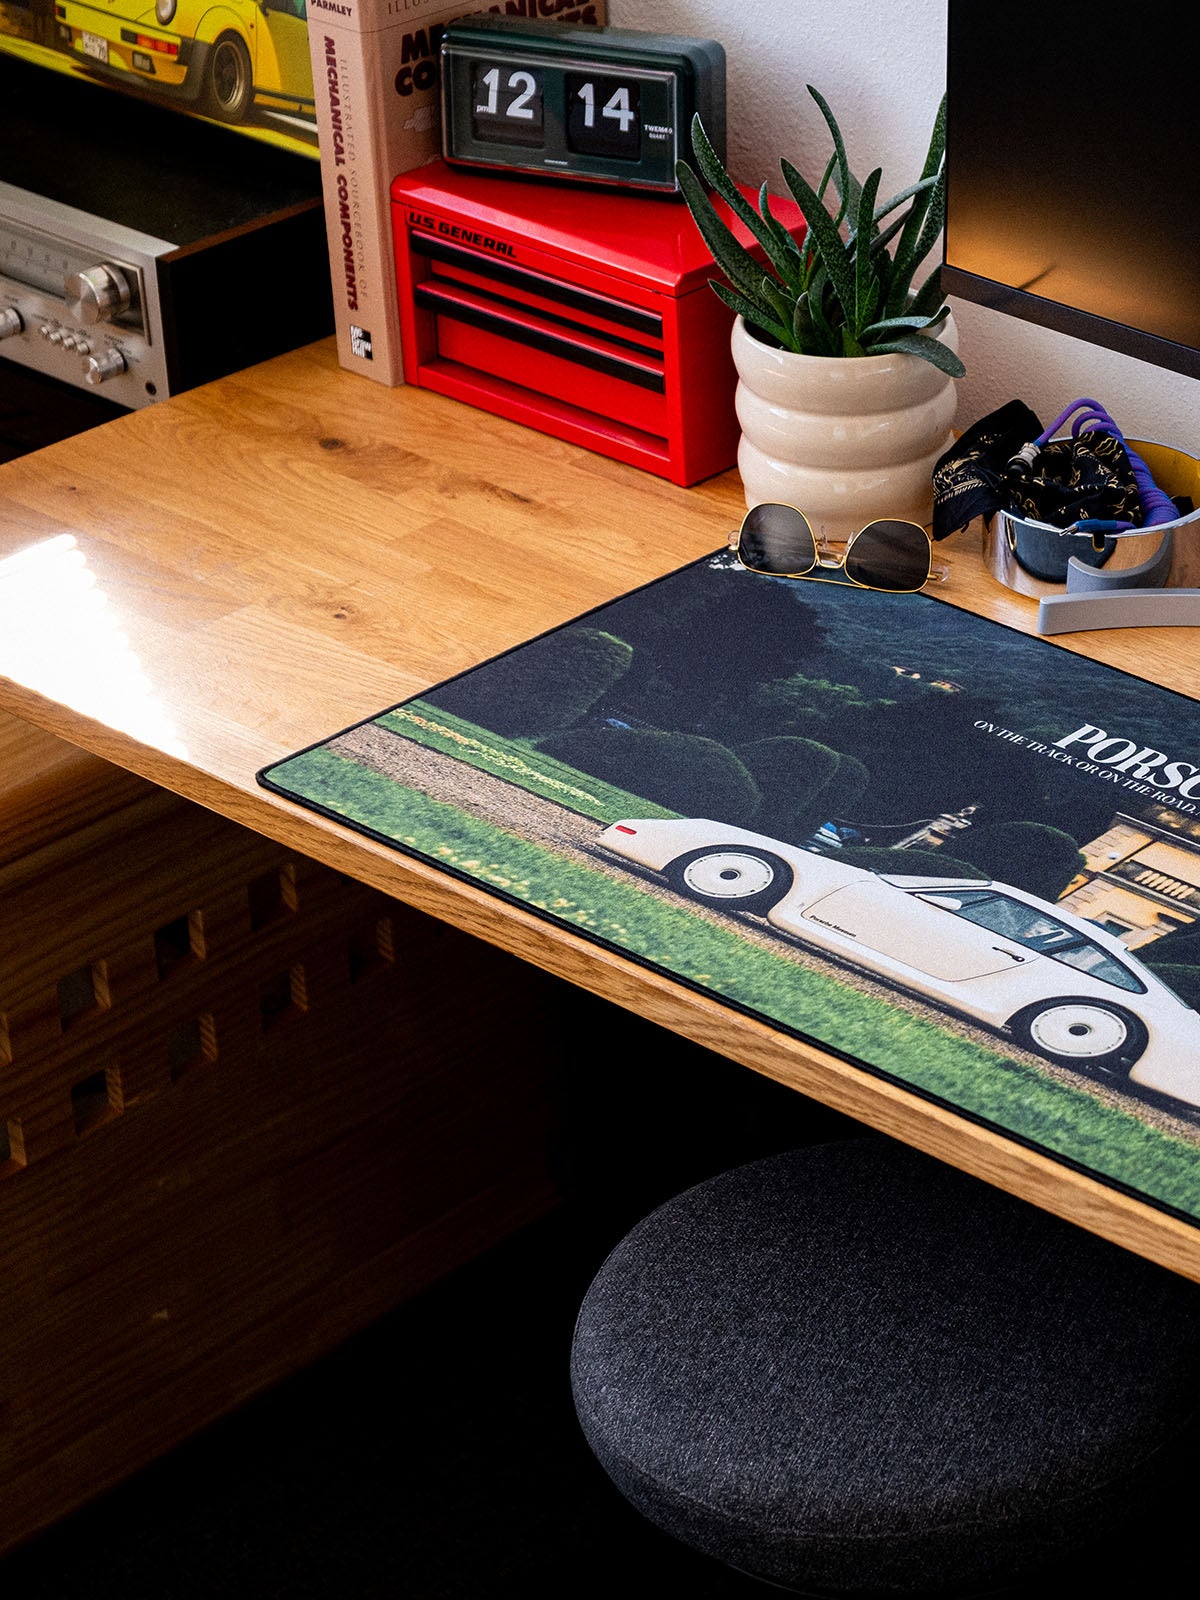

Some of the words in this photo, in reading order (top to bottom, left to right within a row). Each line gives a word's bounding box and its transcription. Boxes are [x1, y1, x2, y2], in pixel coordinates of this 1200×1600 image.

[476, 105, 488, 113] pm
[482, 68, 537, 119] 12
[577, 83, 635, 132] 14
[324, 35, 346, 167] MECHANICAL
[336, 173, 358, 311] COMPONENTS
[438, 221, 517, 258] GENERAL
[973, 720, 999, 733] ON
[997, 728, 1029, 745] THE
[1026, 740, 1078, 765] TRACK
[1075, 761, 1100, 774] OR
[1098, 770, 1124, 783] ON
[1122, 778, 1155, 796] THE
[810, 915, 832, 926] Porsche
